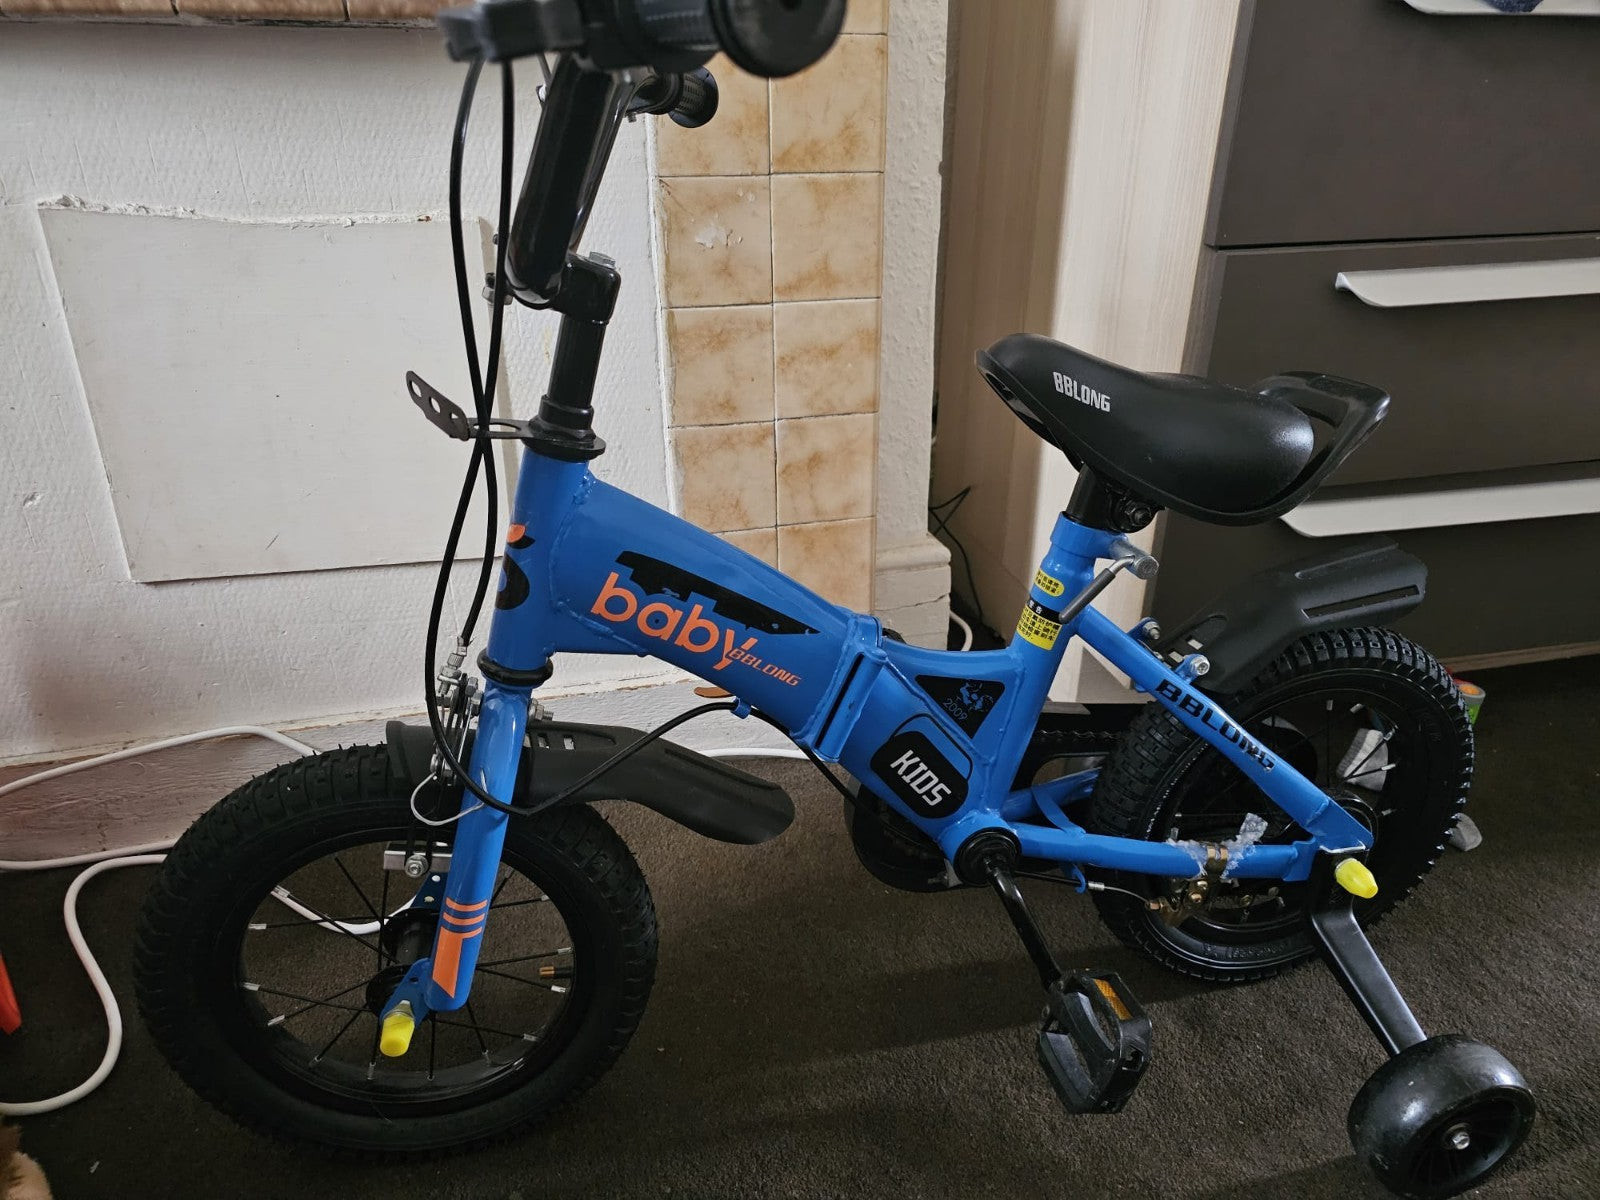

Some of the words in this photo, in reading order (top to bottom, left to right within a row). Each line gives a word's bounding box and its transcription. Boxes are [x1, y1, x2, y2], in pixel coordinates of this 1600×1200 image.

[1053, 372, 1111, 413] BBLONG
[591, 571, 758, 671] baby
[727, 648, 802, 687] BBLONG
[943, 697, 968, 721] 2009
[890, 749, 952, 806] KIDS
